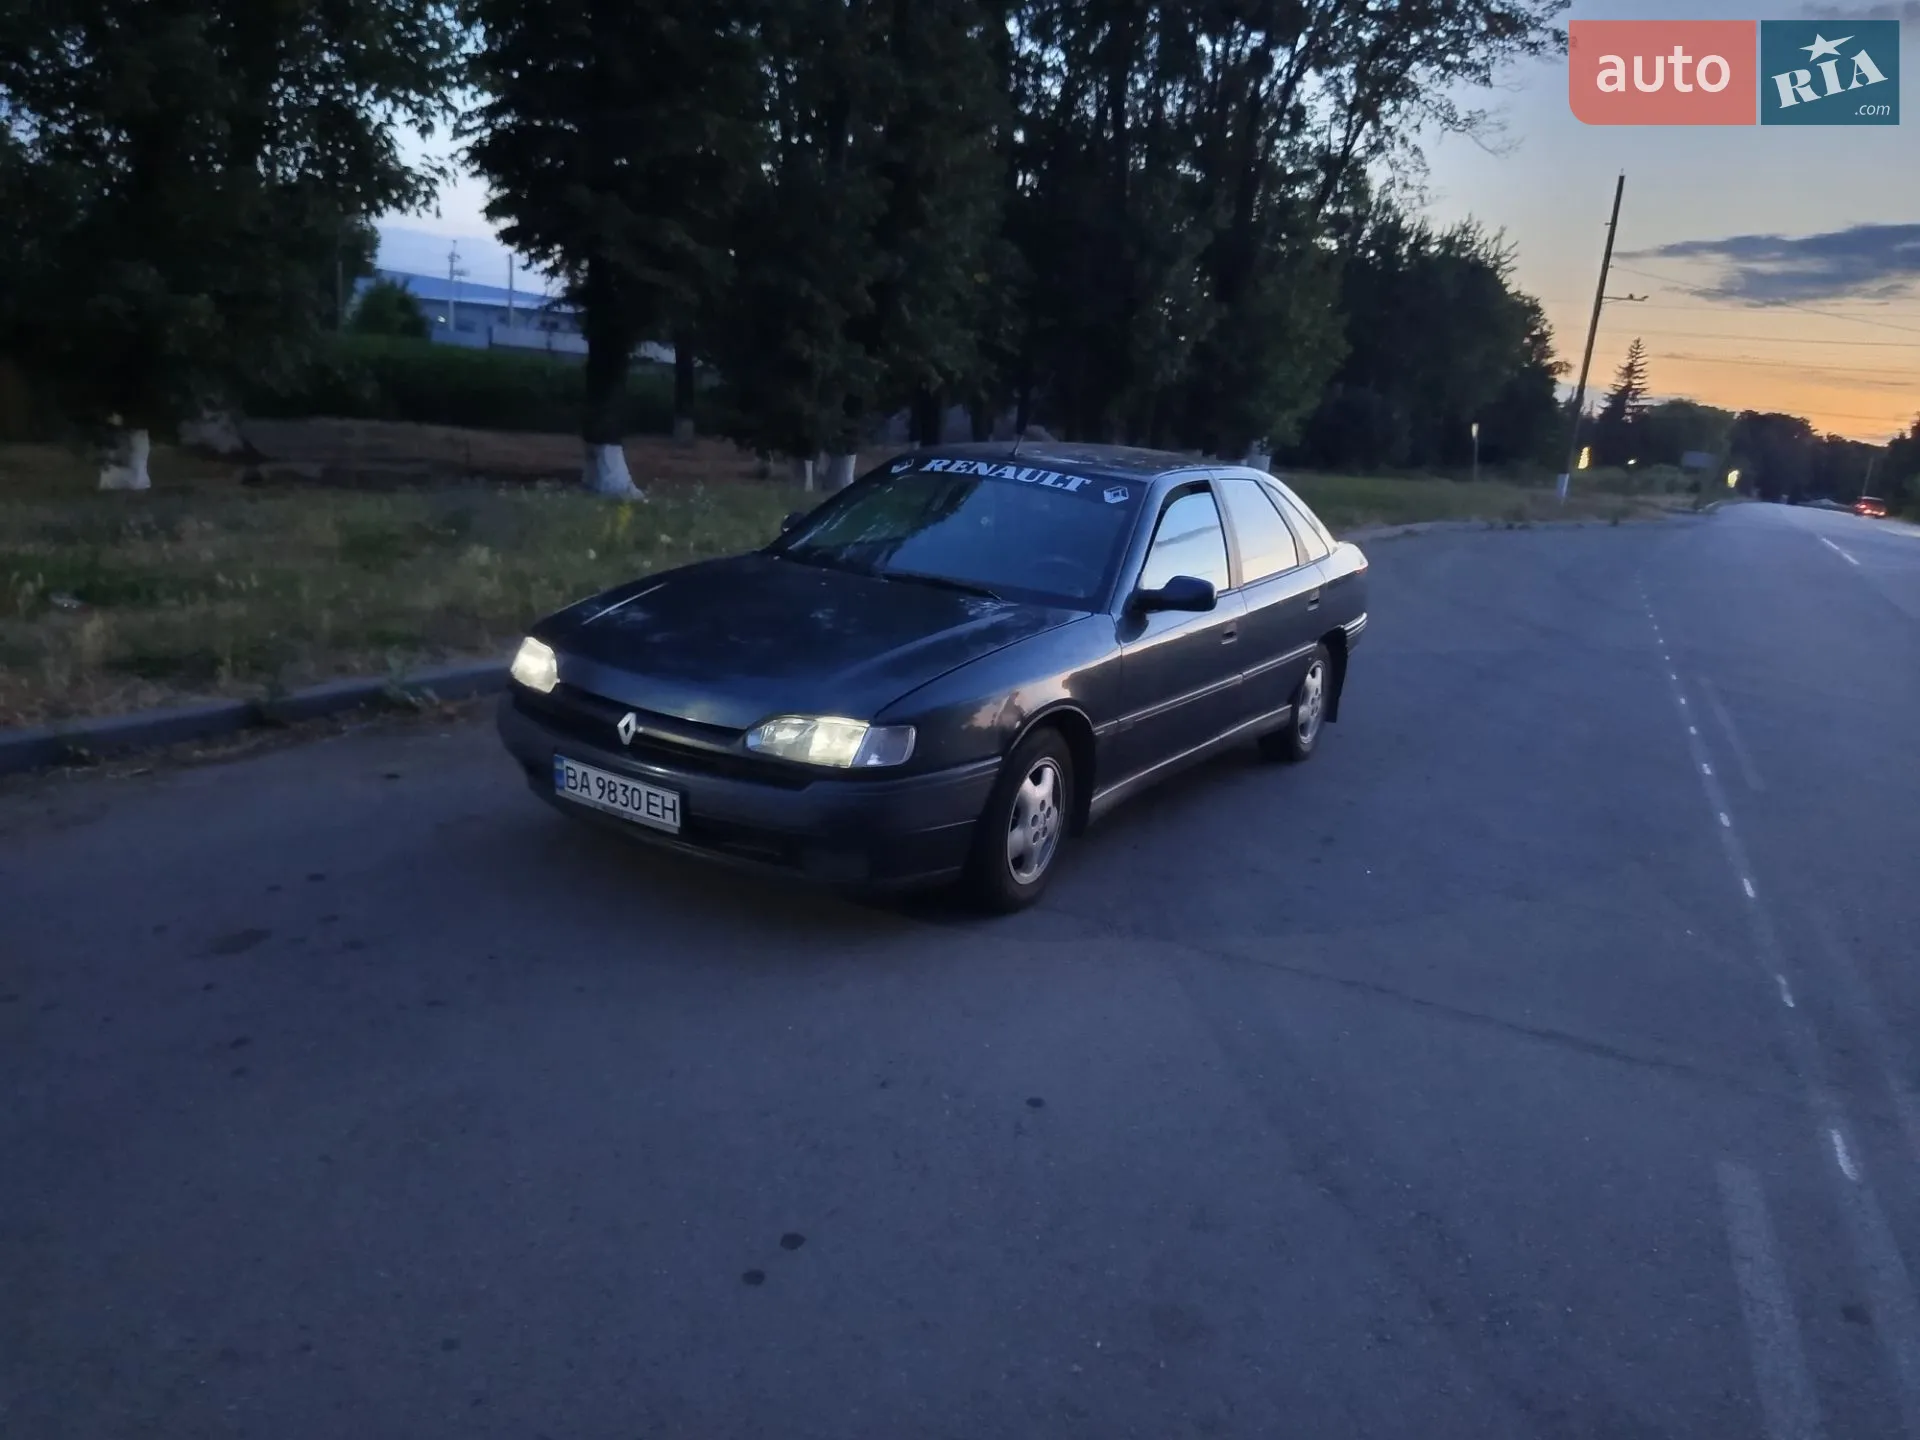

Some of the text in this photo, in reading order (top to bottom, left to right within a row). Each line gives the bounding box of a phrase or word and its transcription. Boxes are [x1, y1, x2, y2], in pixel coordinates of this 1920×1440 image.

[919, 458, 1093, 492] RENAULT
[565, 766, 677, 823] BA 9830 EH
